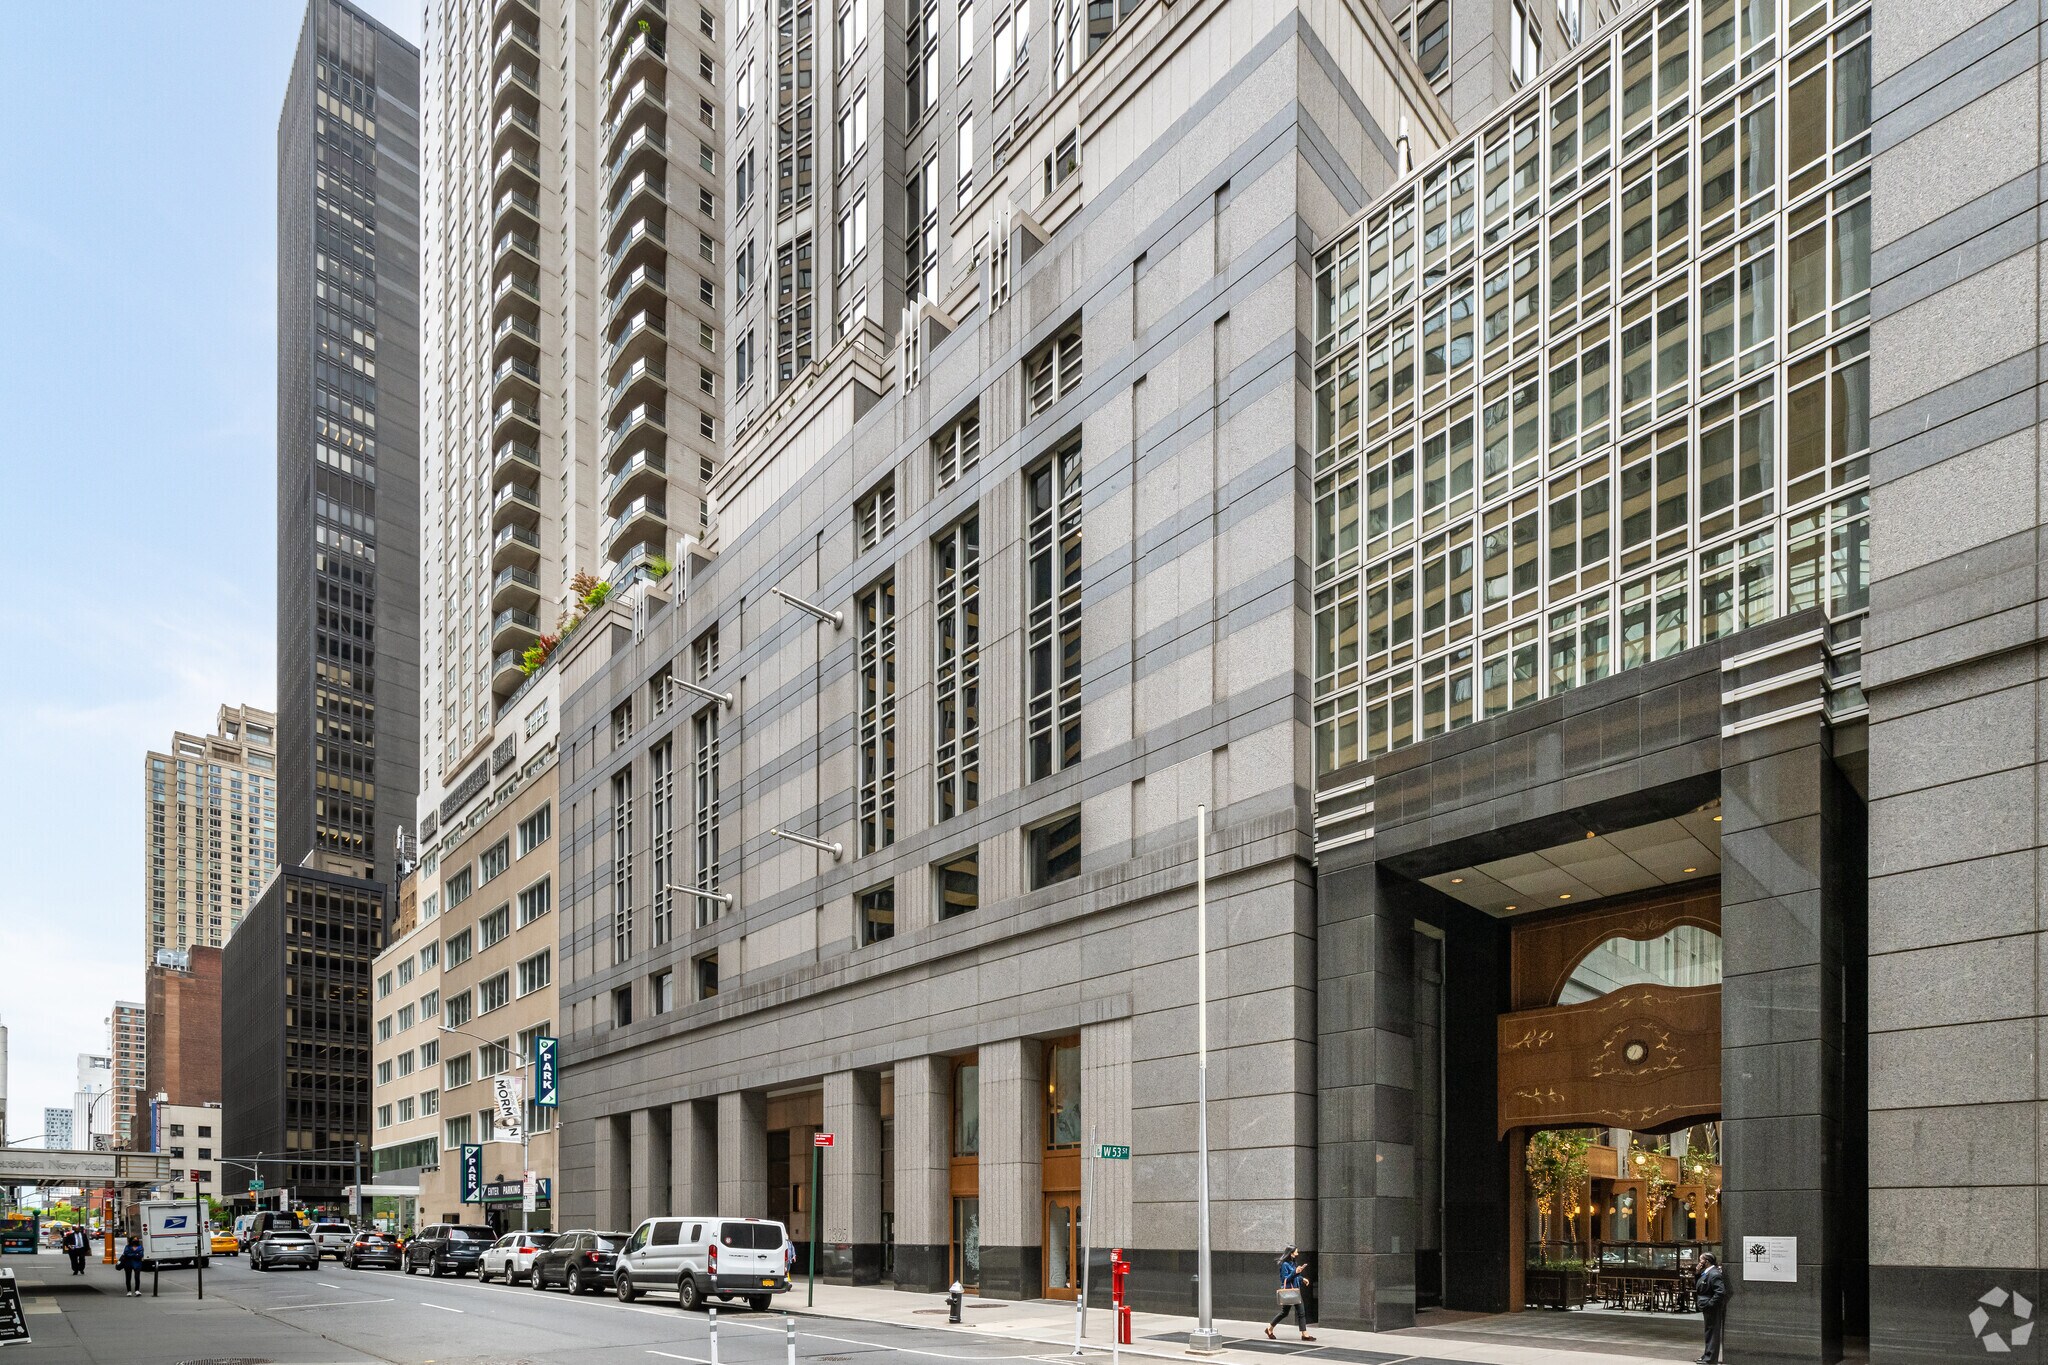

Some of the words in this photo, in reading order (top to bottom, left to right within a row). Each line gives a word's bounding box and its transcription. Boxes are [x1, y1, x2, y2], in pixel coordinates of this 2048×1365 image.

[543, 1053, 552, 1089] PARK
[496, 1080, 519, 1136] MORMN
[1103, 1147, 1111, 1156] W
[1112, 1147, 1121, 1158] 53
[48, 1160, 79, 1170] New
[81, 1161, 114, 1171] York
[468, 1158, 476, 1189] PARK
[488, 1187, 499, 1196] ENTER
[503, 1185, 520, 1194] PARKING
